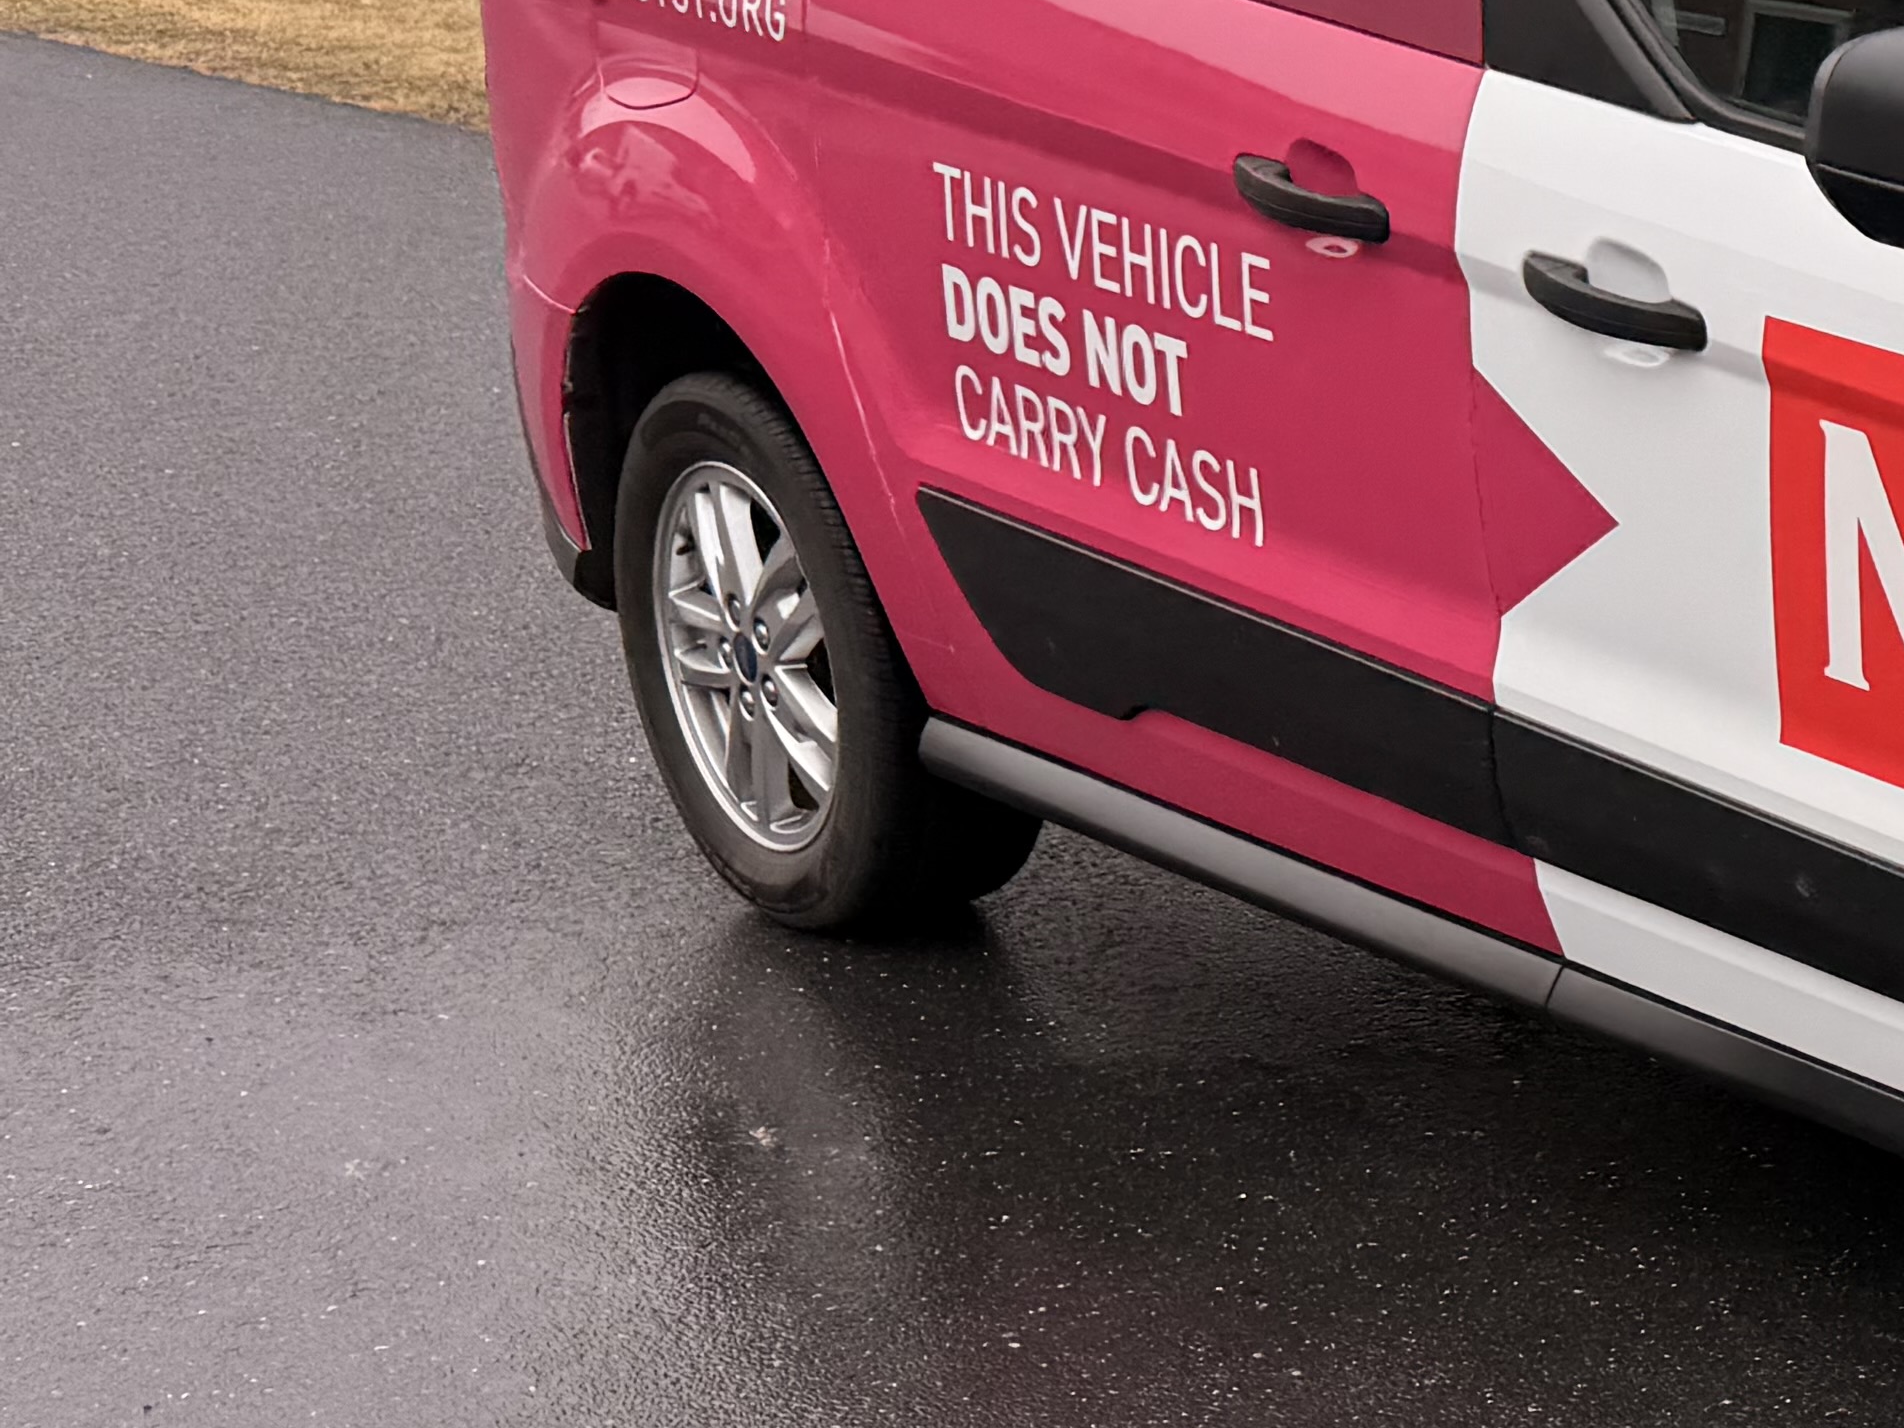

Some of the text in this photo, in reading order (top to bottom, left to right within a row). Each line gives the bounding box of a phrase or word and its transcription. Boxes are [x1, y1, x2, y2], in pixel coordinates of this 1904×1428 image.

[932, 162, 1274, 343] THIS VEHICLE
[943, 264, 1188, 419] DOES NOT
[953, 365, 1266, 548] CARRY CASH
